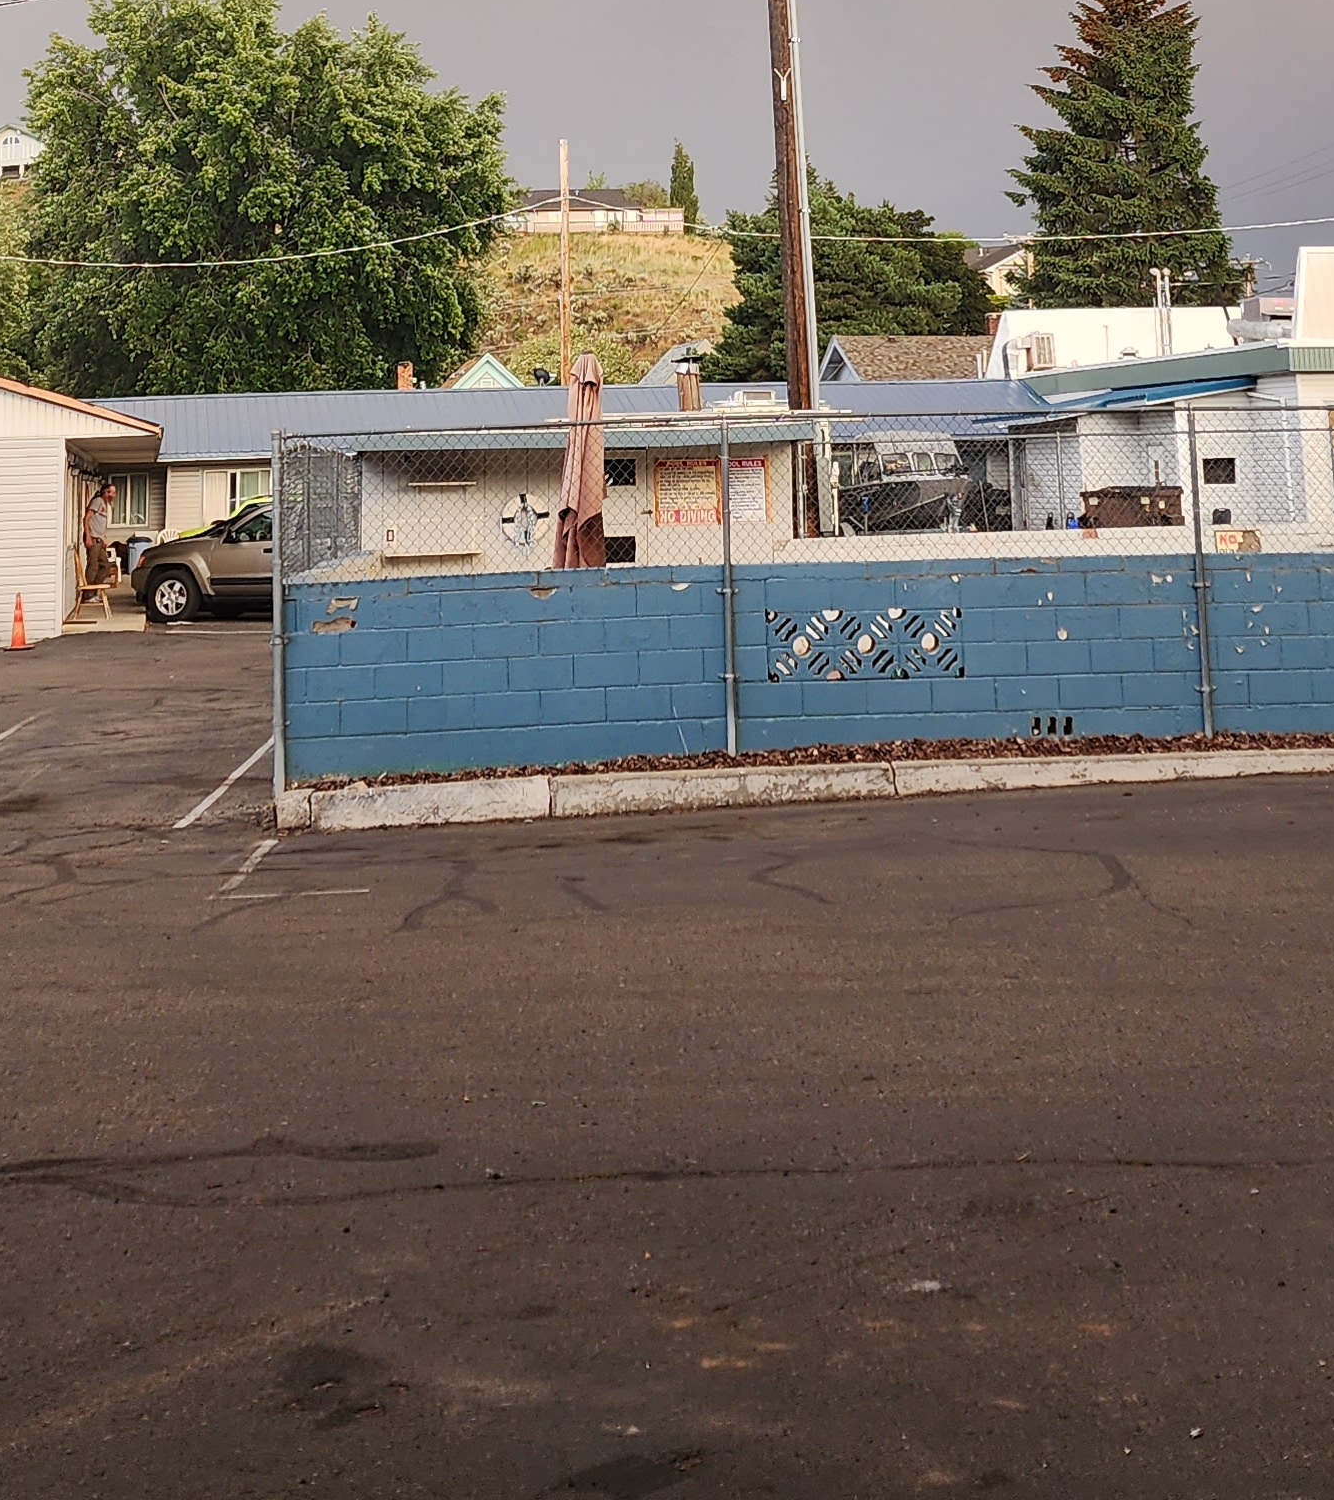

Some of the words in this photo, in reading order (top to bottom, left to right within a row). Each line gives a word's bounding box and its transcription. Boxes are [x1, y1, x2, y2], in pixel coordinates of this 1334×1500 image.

[659, 509, 676, 524] NO
[679, 509, 715, 523] DIVING
[1220, 534, 1238, 545] NO
